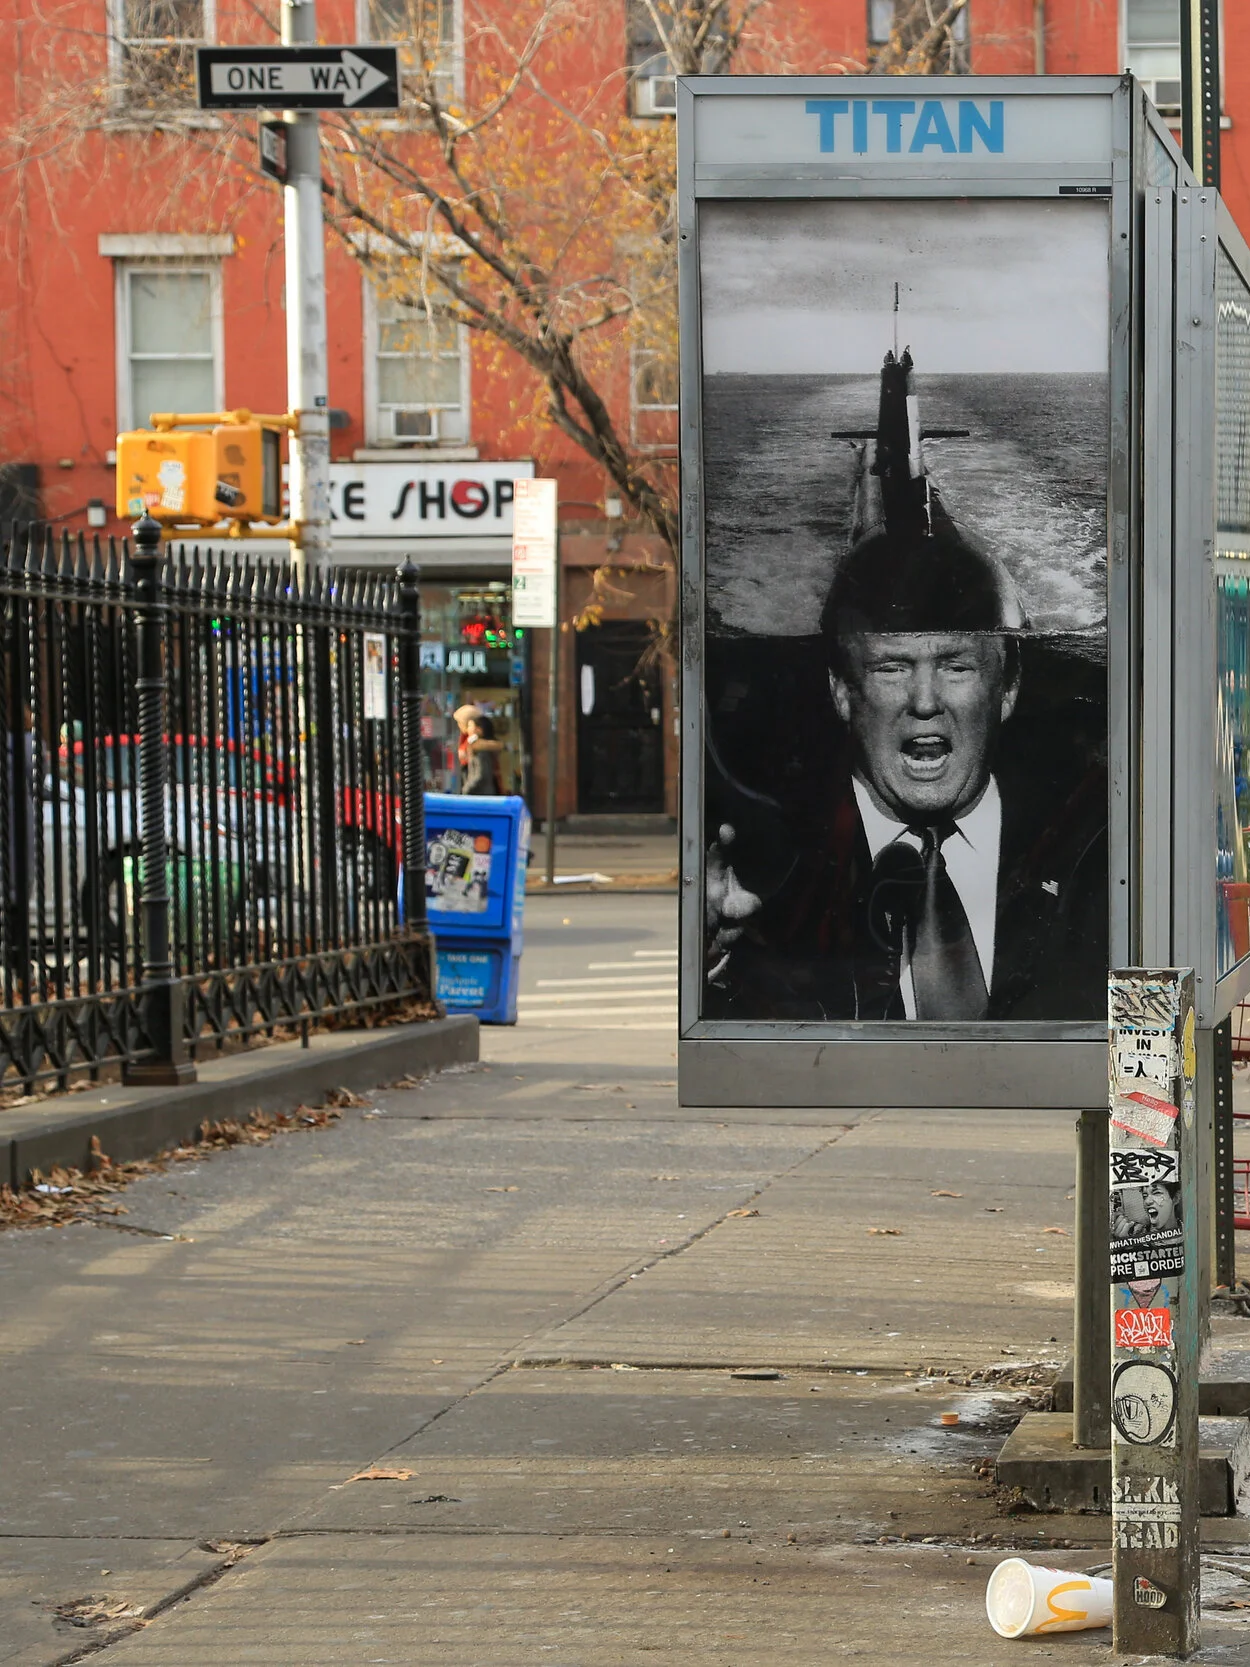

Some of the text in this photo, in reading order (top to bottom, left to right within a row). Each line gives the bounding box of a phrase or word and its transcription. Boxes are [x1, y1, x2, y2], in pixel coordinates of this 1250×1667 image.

[227, 66, 369, 91] ONE WAY
[805, 101, 1005, 153] TITAN
[390, 478, 514, 520] SHOP
[1136, 1038, 1152, 1051] IN
[1110, 1245, 1184, 1265] KICKSTARTER
[1110, 1257, 1185, 1277] PRE ORDER
